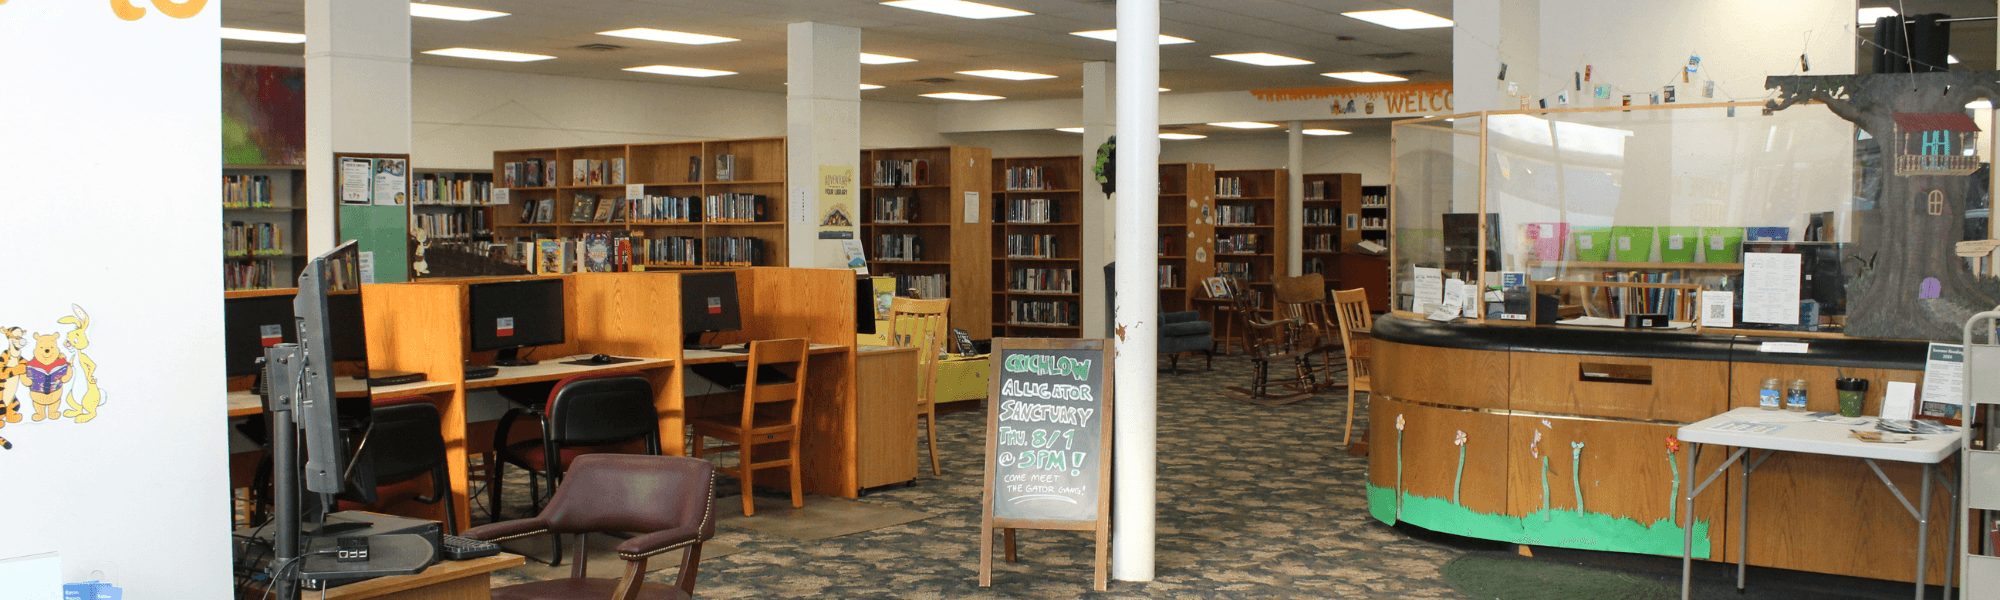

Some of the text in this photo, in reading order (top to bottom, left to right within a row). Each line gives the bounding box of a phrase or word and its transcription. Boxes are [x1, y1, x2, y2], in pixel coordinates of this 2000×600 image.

[834, 188, 848, 196] LIBRARY
[1005, 354, 1091, 381] CRICHLOW
[1002, 378, 1093, 401] ALLIGATOR
[999, 400, 1093, 427] SANCTUARY
[999, 426, 1075, 450] THU. 8/1
[1004, 474, 1060, 483] COME MEET
[1007, 484, 1086, 496] THE GATOR GANG!
